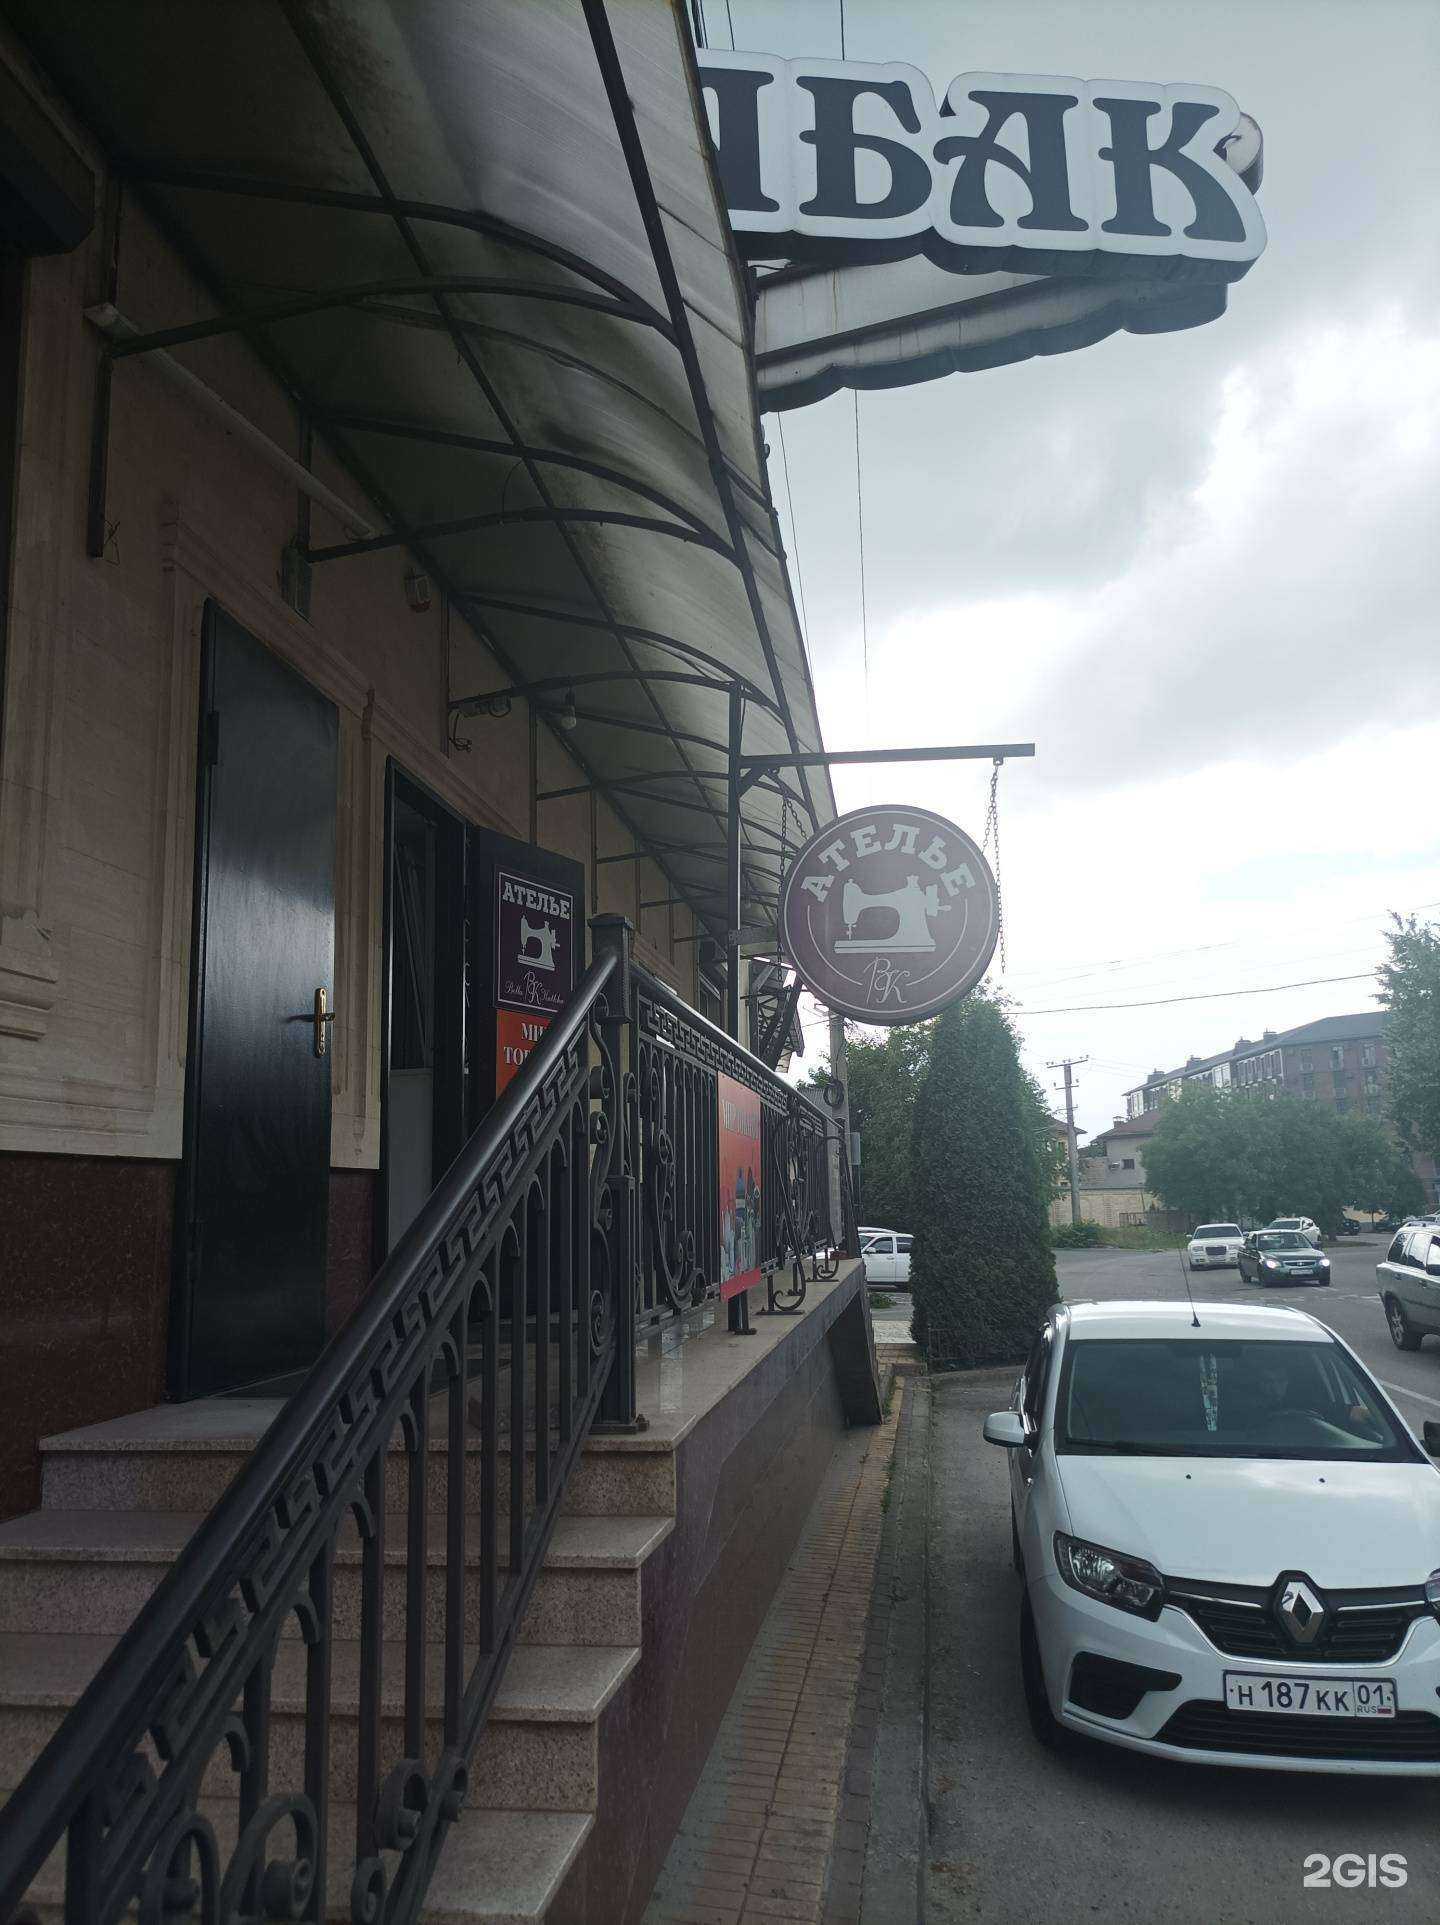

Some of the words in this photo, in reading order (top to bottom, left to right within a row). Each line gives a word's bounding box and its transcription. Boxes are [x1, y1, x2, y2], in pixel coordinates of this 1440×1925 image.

[801, 823, 977, 903] АТЕЛЬЕ
[502, 882, 570, 920] АТЕЛЬЕ
[1357, 1706, 1377, 1714] RUS
